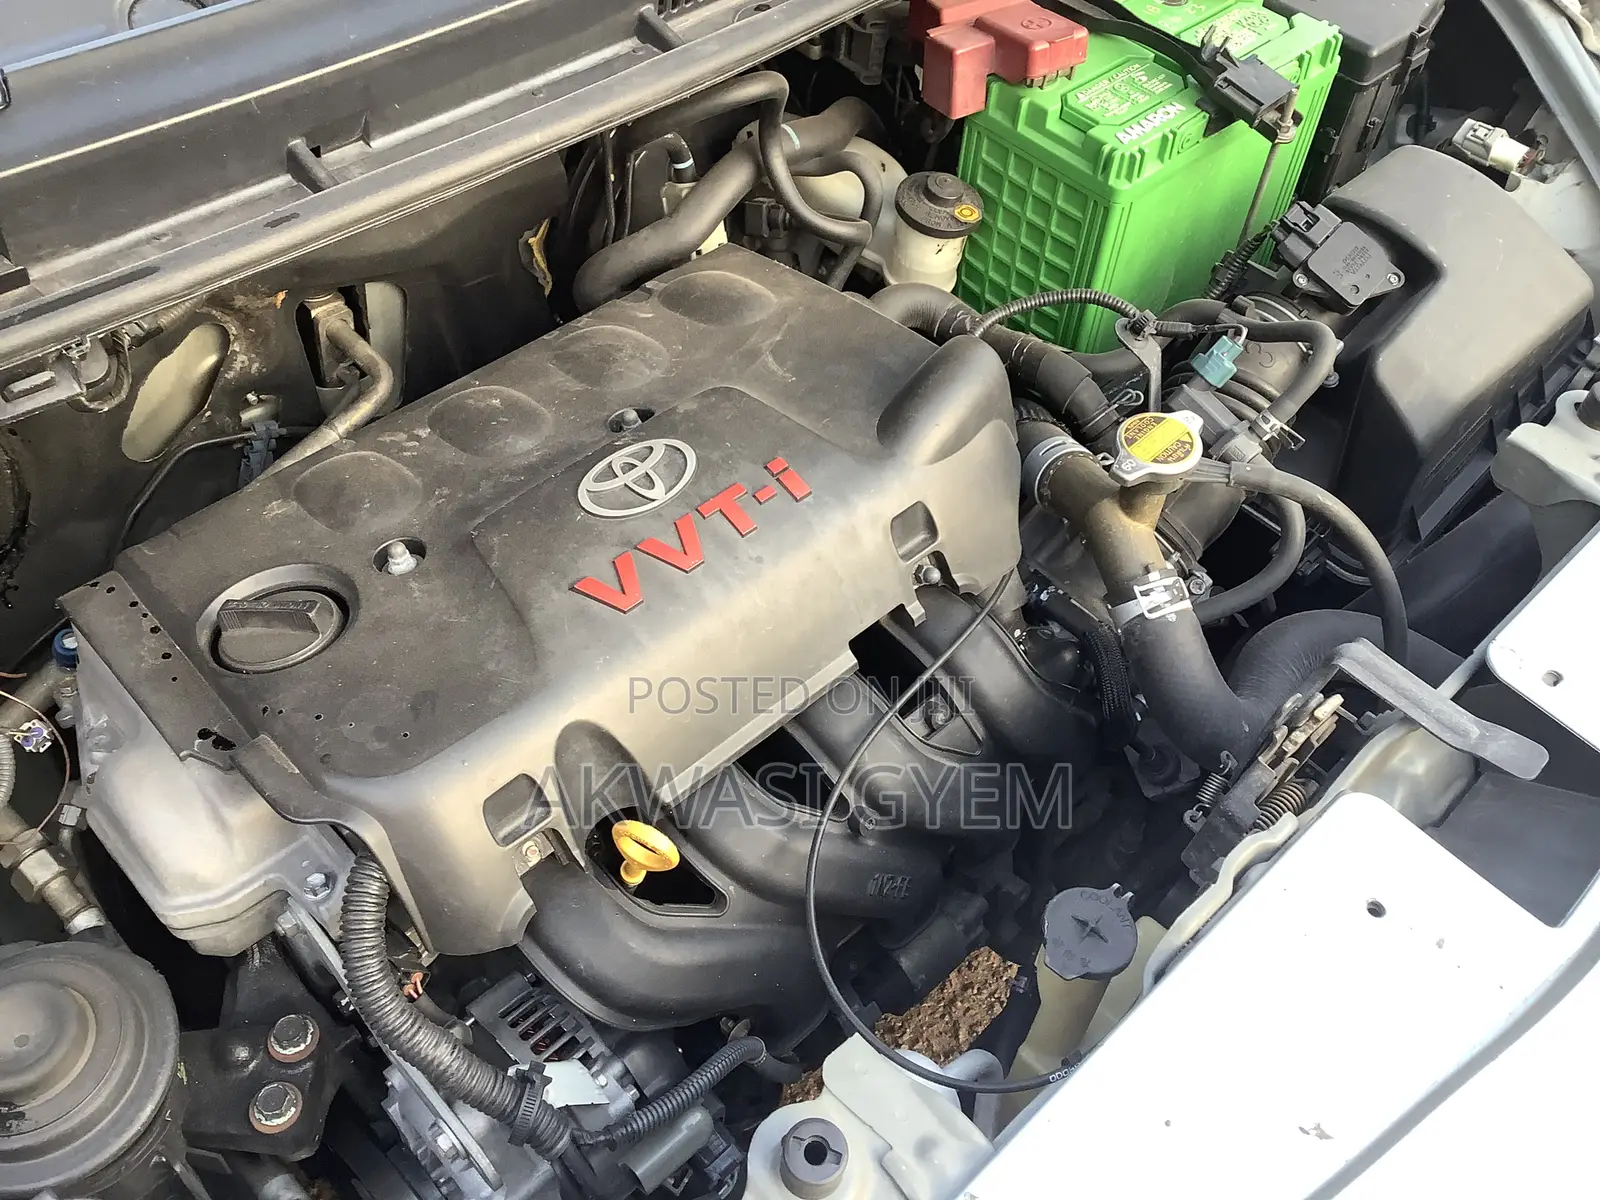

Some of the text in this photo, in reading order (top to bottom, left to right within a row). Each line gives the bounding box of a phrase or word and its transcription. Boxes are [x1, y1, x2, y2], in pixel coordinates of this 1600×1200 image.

[1115, 101, 1186, 145] AMARON
[1126, 417, 1154, 439] COOLANT
[1134, 422, 1158, 441] ENGINE
[1155, 440, 1182, 462] CAUTION
[568, 456, 813, 615] VVT-i
